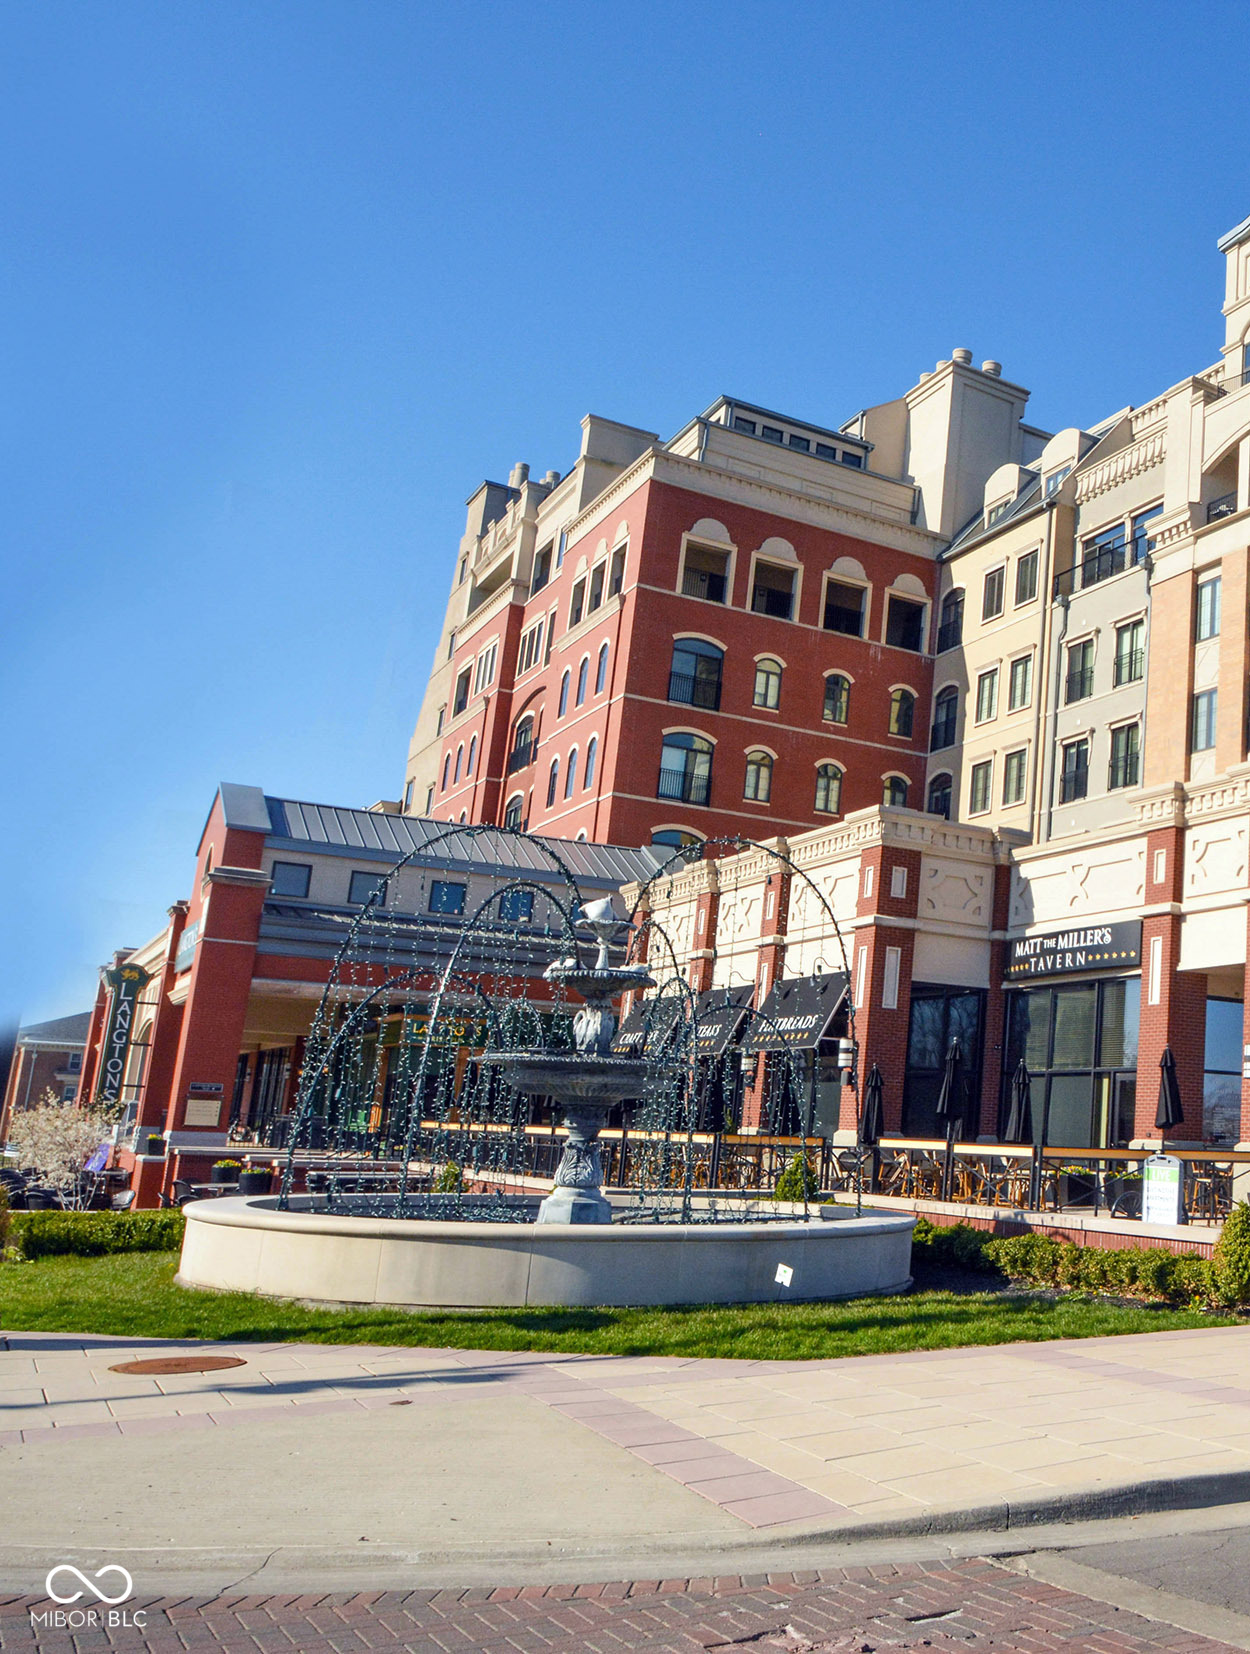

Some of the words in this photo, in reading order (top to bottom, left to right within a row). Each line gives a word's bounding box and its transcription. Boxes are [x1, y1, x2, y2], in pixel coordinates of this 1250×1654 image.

[1015, 937, 1043, 957] MATT
[1043, 937, 1057, 949] THE
[1057, 927, 1112, 950] MILLER'S
[1029, 950, 1086, 972] TAVERN
[619, 1032, 644, 1043] CRAFT
[696, 1024, 722, 1037] TEAKS
[104, 982, 132, 1101] LANGTONS
[1152, 1168, 1172, 1182] LIVE
